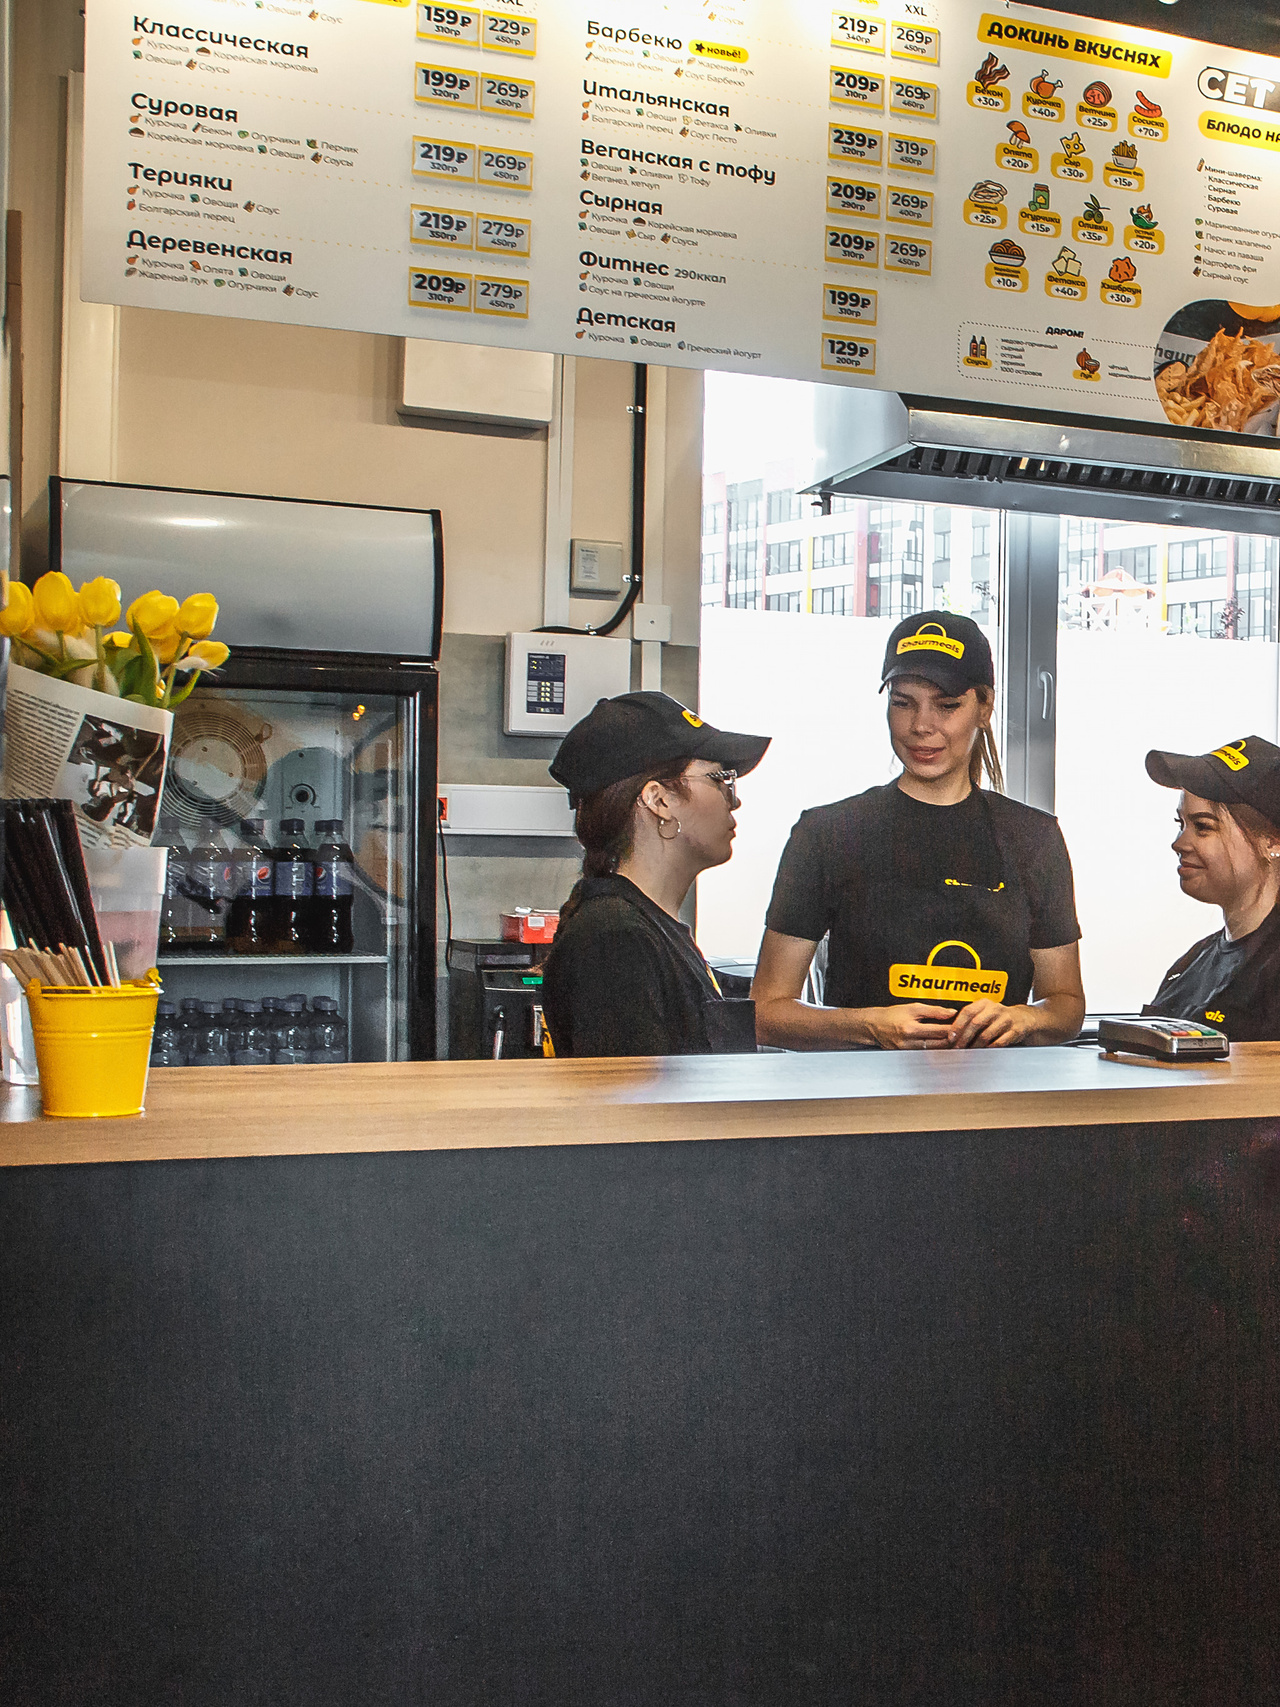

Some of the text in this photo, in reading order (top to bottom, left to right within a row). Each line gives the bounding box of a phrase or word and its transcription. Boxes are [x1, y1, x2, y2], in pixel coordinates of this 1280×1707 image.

[905, 4, 927, 17] XXL
[133, 16, 309, 58] Классическая
[587, 20, 682, 50] Барбекю
[975, 85, 1003, 98] Бекон
[1198, 67, 1276, 109] СЕТ
[583, 79, 730, 117] Итальянская
[1026, 95, 1062, 108] Курочка
[131, 93, 238, 122] Суровая
[1132, 115, 1165, 128] Сосиска
[201, 125, 232, 137] Бекон
[690, 129, 737, 144] Соус Песто
[1207, 119, 1262, 140] БЛЮДО
[147, 131, 254, 153] Корейская морковка
[251, 132, 300, 146] Огурчики
[321, 142, 359, 154] Перчик
[581, 139, 776, 186] Веганская с тофу
[1063, 158, 1081, 167] Сыр
[128, 162, 233, 191] Терияки
[202, 197, 238, 209] Овощи
[256, 204, 280, 215] Соус
[580, 190, 663, 215] Сырная
[139, 203, 236, 223] Болгарский перец
[1020, 211, 1060, 224] Огурчики
[637, 231, 655, 241] Сыр
[648, 220, 738, 239] Корейская морковка
[126, 230, 293, 265] Деревенская
[579, 251, 727, 284] Фитнес 290ккал
[227, 280, 277, 293] Огурчики
[588, 286, 609, 296] Соус
[576, 308, 676, 333] Детская
[1045, 326, 1084, 339] ДАРОМ!
[967, 358, 988, 367] Соусы
[900, 640, 960, 653] Shaurmeals
[898, 974, 1001, 994] Shaurmeals
